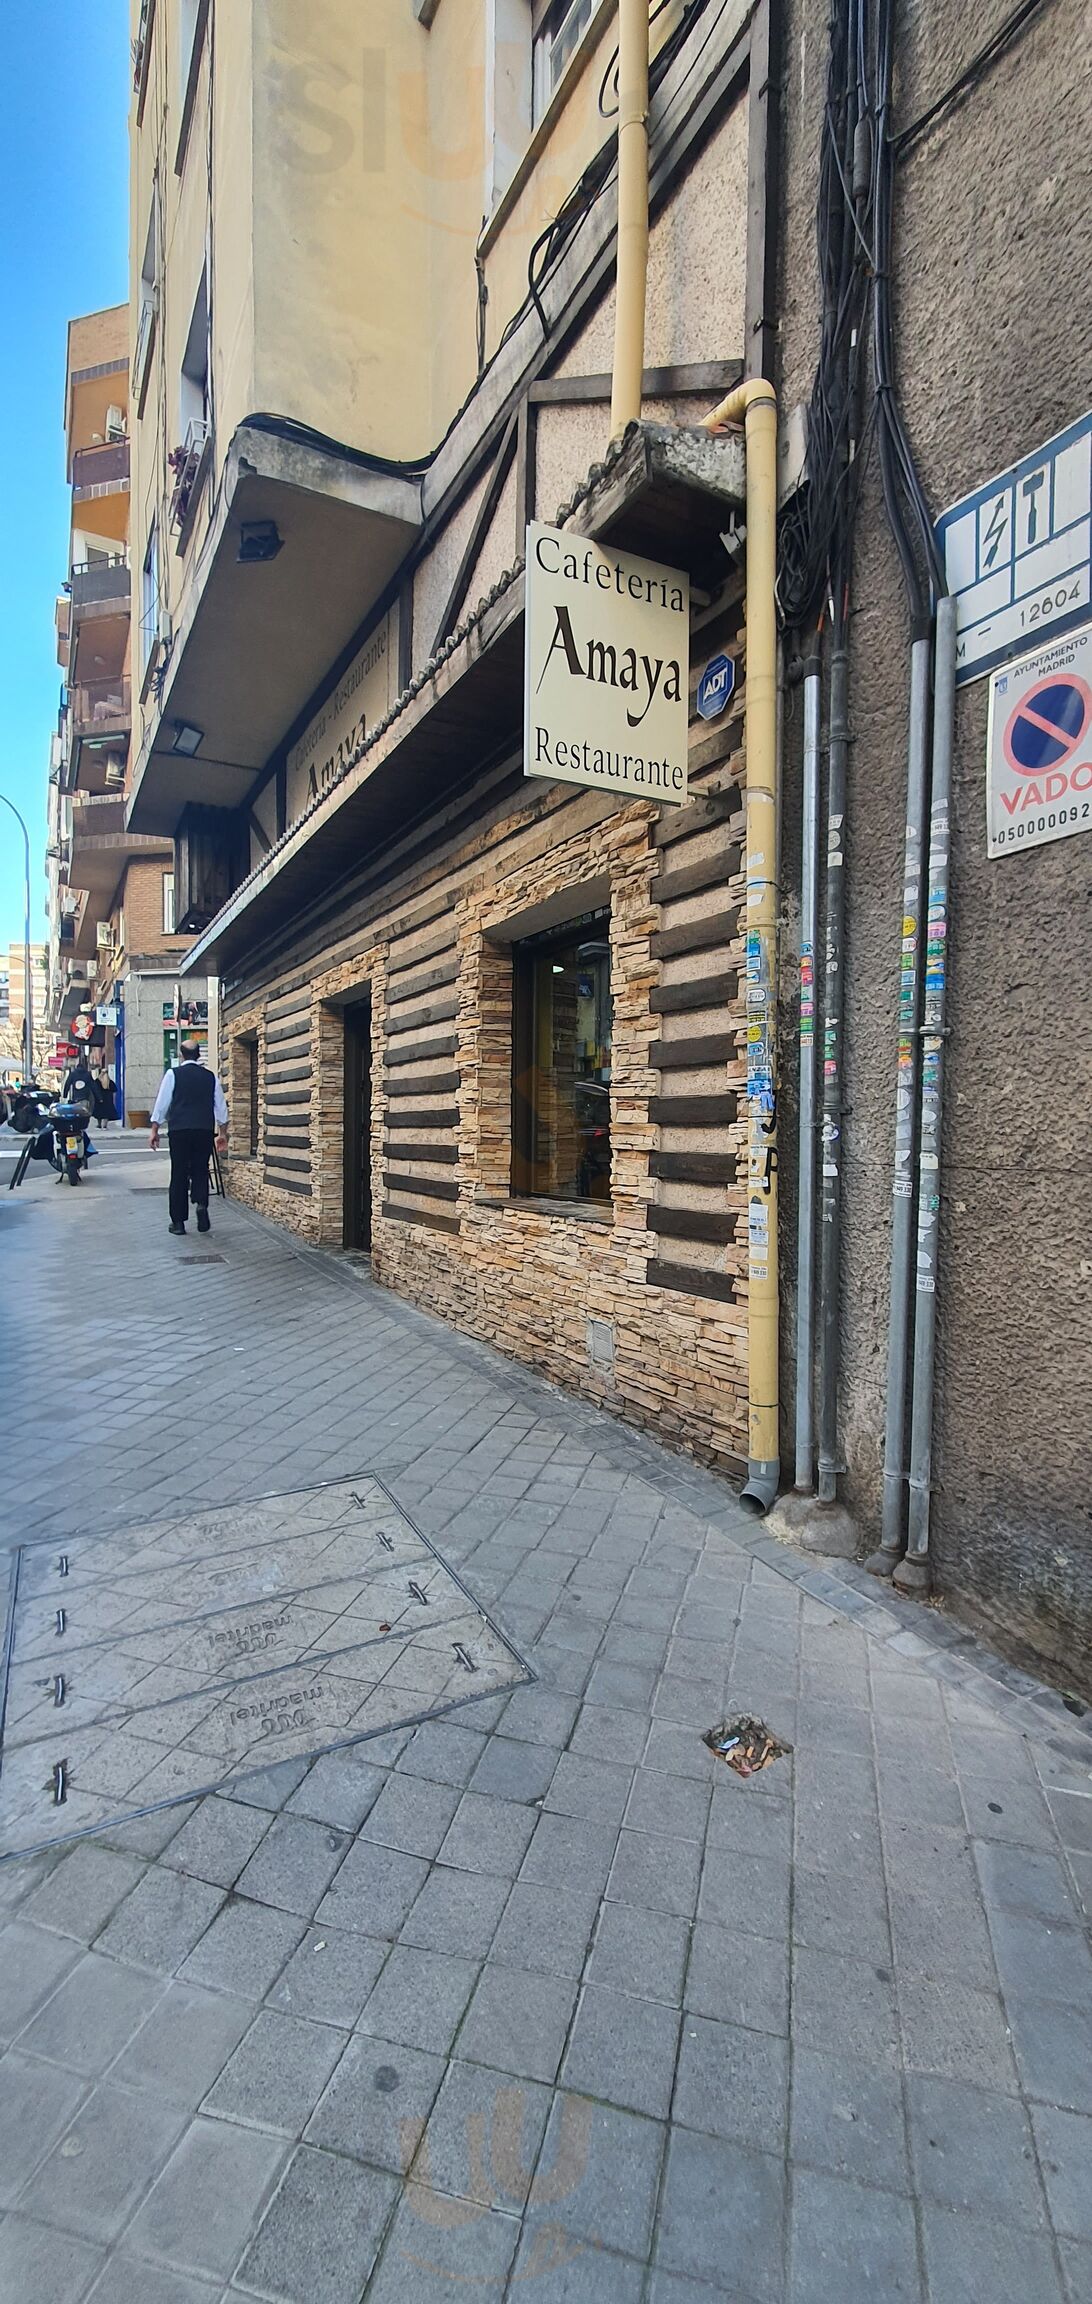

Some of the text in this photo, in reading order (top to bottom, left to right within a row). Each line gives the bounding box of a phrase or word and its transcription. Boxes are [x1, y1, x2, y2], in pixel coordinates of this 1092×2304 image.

[536, 537, 685, 612] Cafetería
[1019, 580, 1081, 627] 12604
[536, 605, 682, 728] Amaya
[1013, 636, 1088, 678] AYUNTAMIENTO
[1038, 654, 1076, 677] MADRID
[703, 667, 728, 700] ADT
[535, 727, 684, 790] Restaurante
[1000, 761, 1092, 816] VADO
[208, 1614, 293, 1649] madritel
[229, 1685, 324, 1726] madritel
